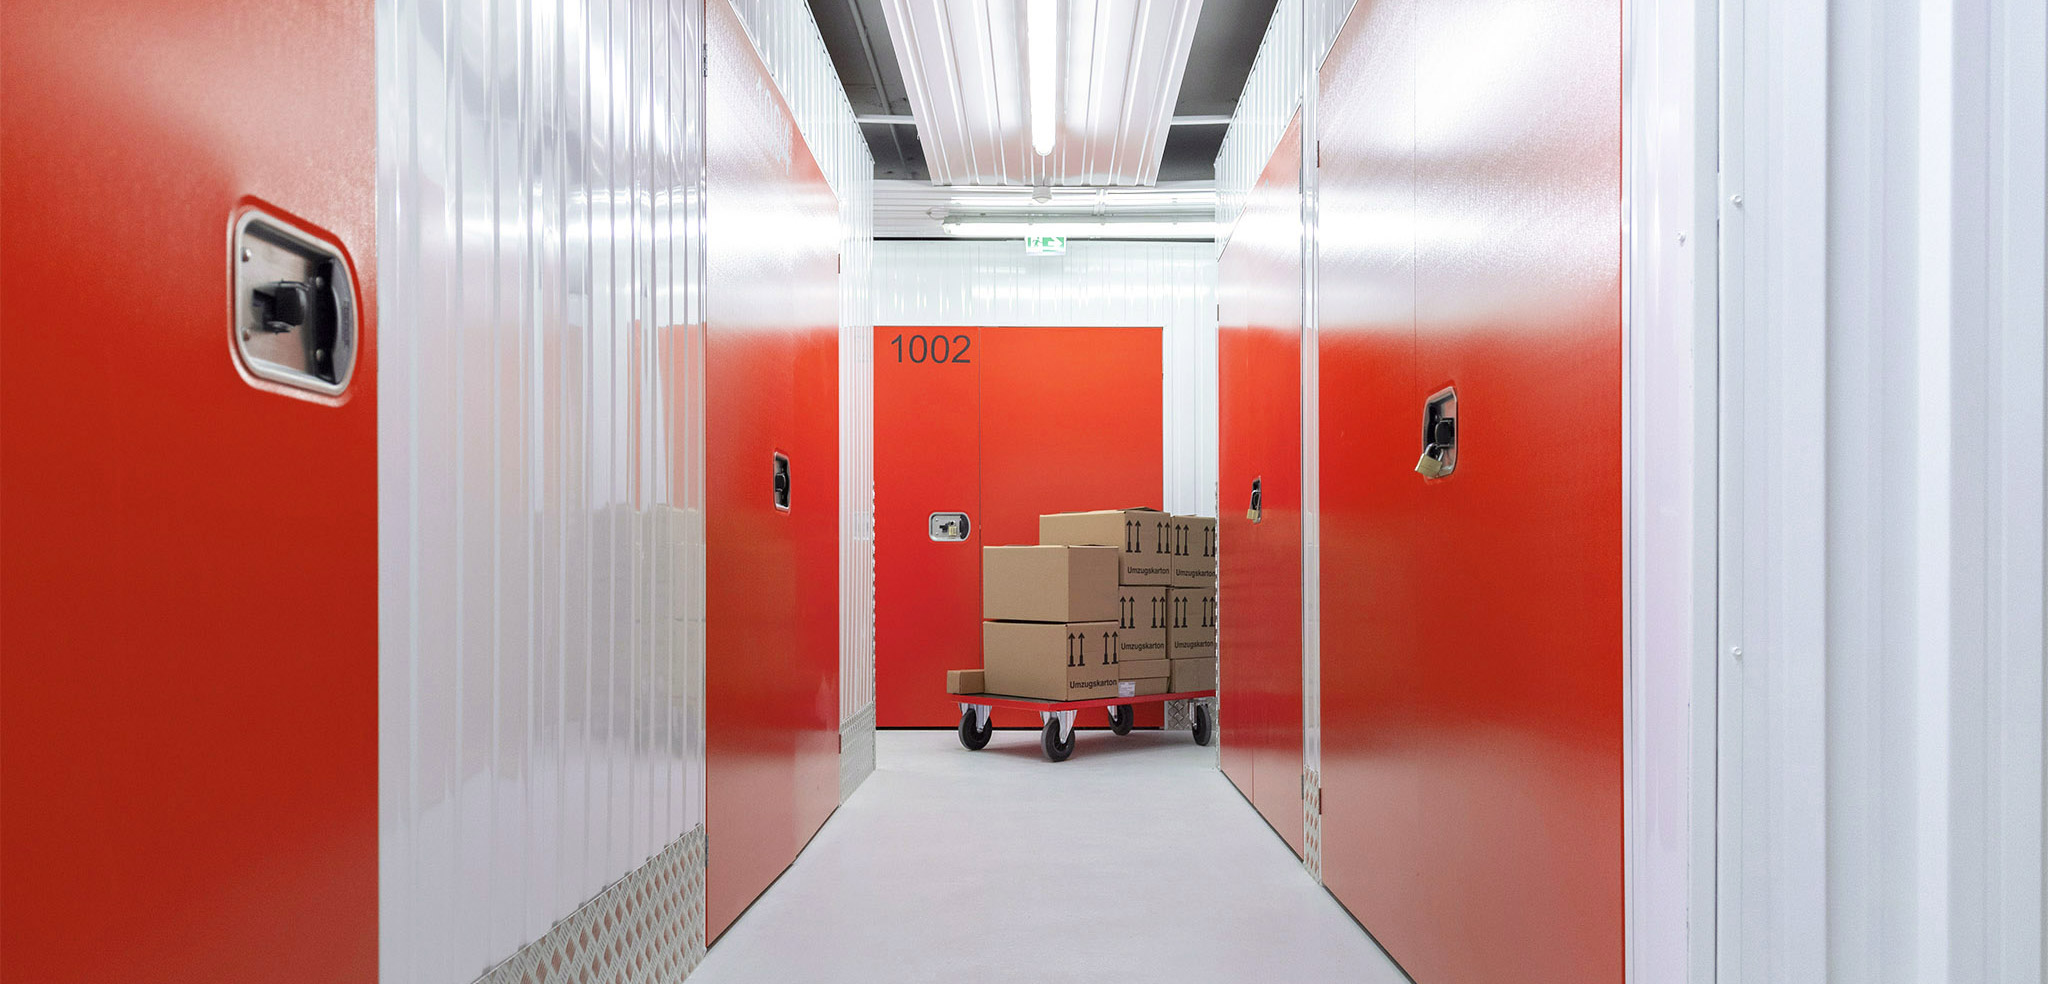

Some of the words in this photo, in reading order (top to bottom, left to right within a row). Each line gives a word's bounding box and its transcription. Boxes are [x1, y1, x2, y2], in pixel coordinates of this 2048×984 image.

[891, 334, 971, 363] 1002
[1127, 566, 1170, 576] Umzugskarton
[1121, 642, 1164, 652] Umzugskarton
[1174, 640, 1214, 650] Umzugskarton
[1069, 679, 1117, 690] Umzugskarton
